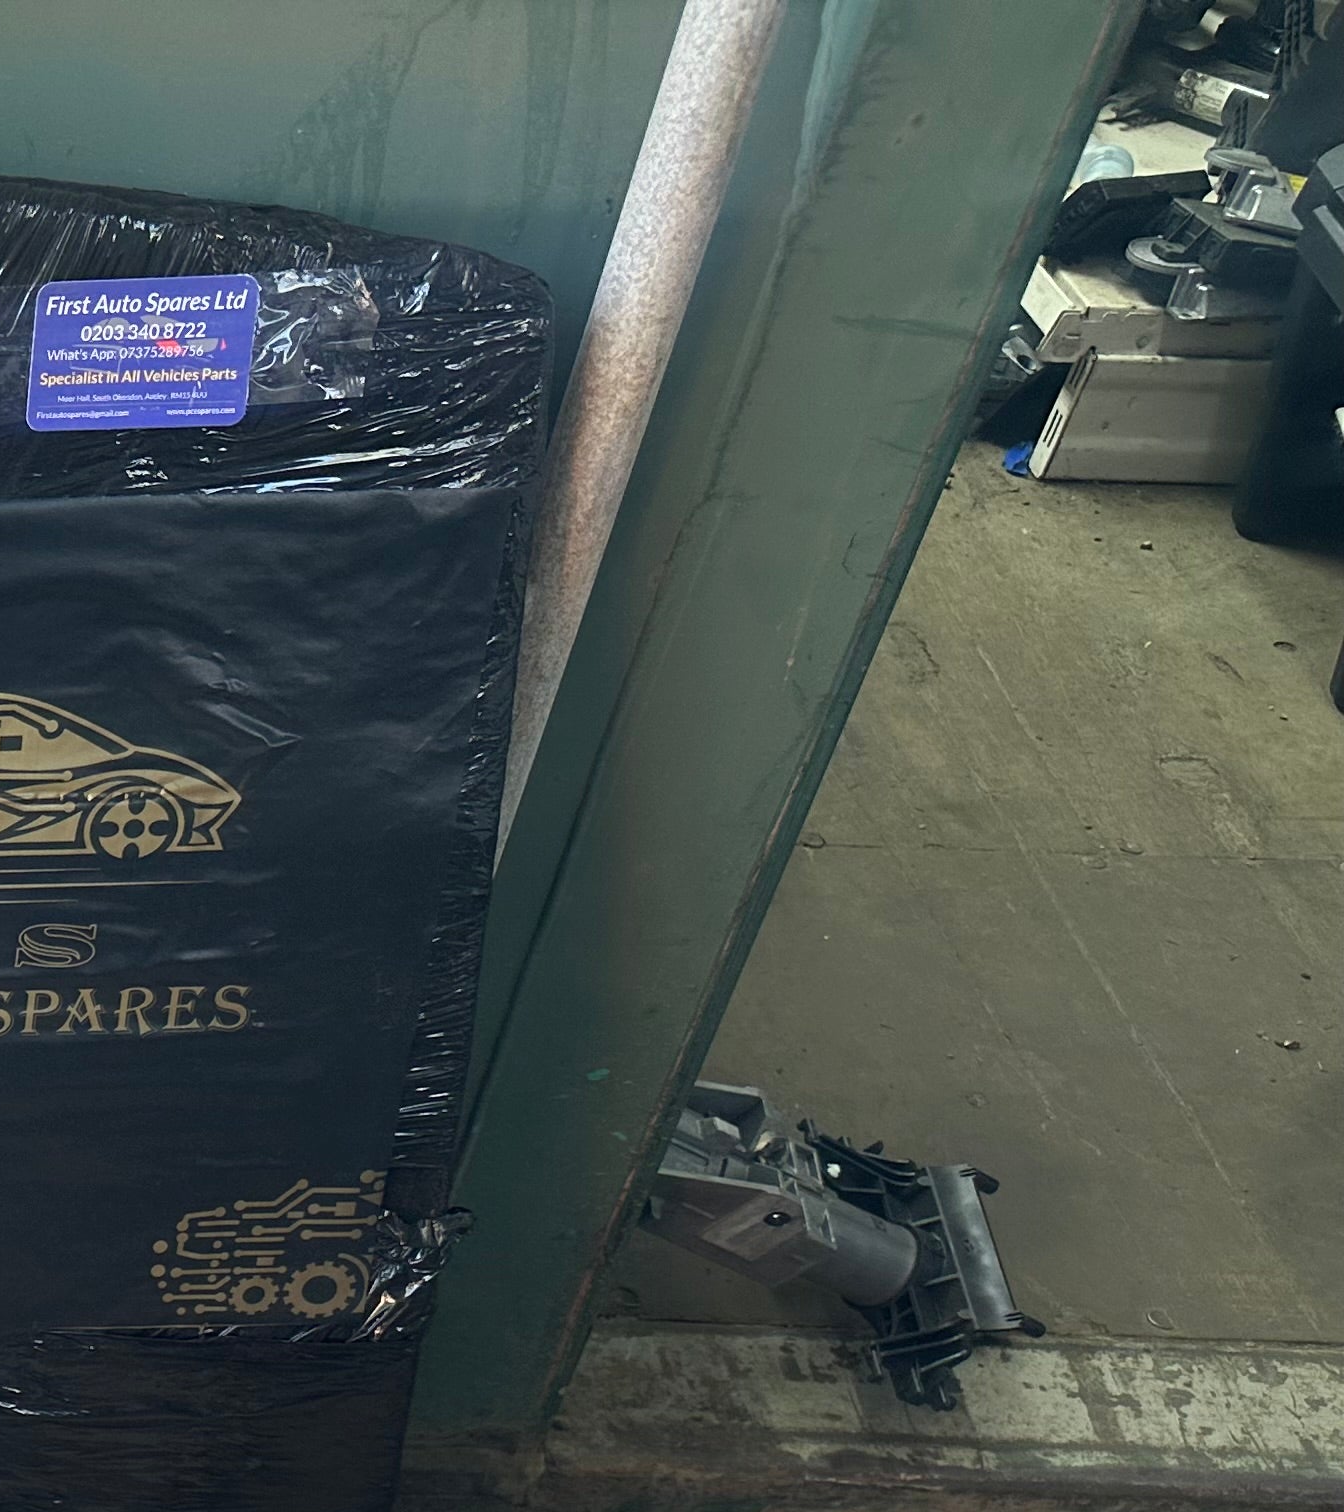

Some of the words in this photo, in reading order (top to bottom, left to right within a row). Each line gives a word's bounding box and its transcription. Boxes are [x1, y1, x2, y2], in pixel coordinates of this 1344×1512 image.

[46, 296, 89, 316] First
[93, 294, 142, 315] Auto
[144, 292, 210, 315] Spares
[214, 289, 248, 311] Ltd
[80, 324, 124, 342] 0203
[127, 323, 160, 341] 340
[163, 322, 207, 339] 8722
[47, 347, 88, 361] What's
[119, 344, 204, 359] 07375289756
[40, 371, 104, 388] Specialist
[106, 370, 119, 384] in
[121, 370, 140, 384] All
[143, 368, 200, 382] Vehicles
[202, 367, 237, 381] Parts
